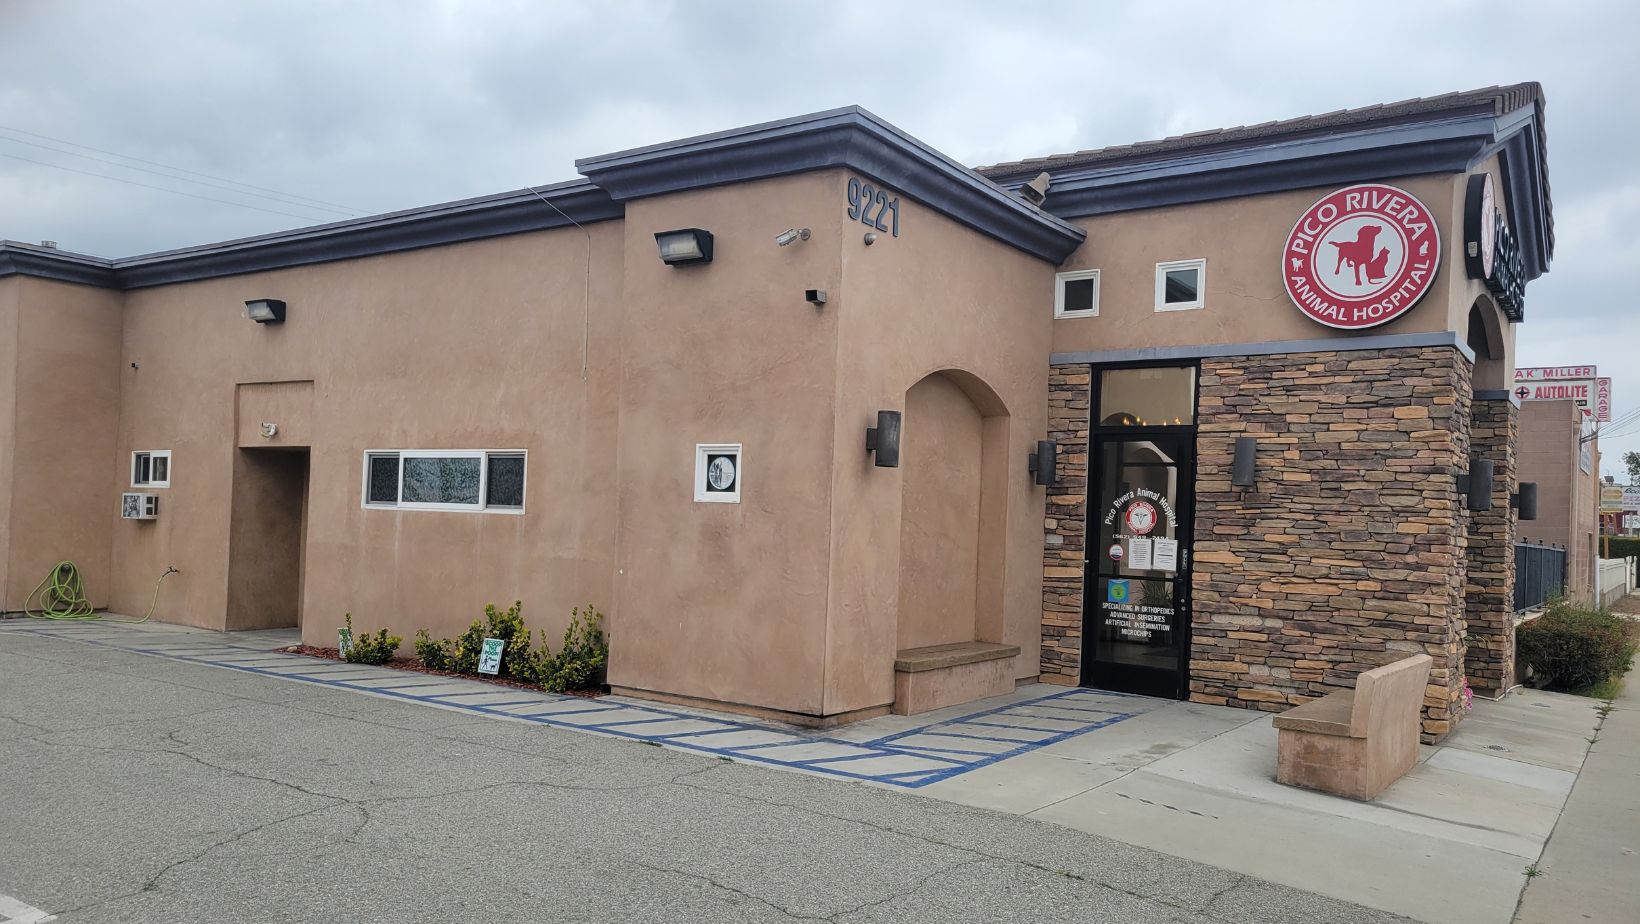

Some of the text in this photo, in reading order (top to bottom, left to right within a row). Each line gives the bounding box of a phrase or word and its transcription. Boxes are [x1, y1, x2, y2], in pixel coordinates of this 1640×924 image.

[847, 176, 899, 238] 9221
[1291, 203, 1338, 254] PICO
[1346, 191, 1428, 240] RIVERA
[1291, 276, 1348, 321] ANIMAL
[1353, 259, 1430, 321] HOSPITAL
[1515, 367, 1591, 378] AK MILLER
[1535, 384, 1588, 399] AUTOLITE
[1598, 379, 1609, 419] GARAGE
[1104, 508, 1116, 525] Pico
[1113, 491, 1135, 509] Rivera
[1136, 487, 1161, 501] Animal
[1158, 496, 1179, 528] Hospital
[1102, 602, 1132, 611] SPECIALIZING
[1141, 606, 1174, 615] ORTHOPEDICS
[1104, 618, 1171, 631] ARTIFICIAL INSEMINATION
[1109, 611, 1166, 623] ADVANCED SURGERIES
[1121, 628, 1152, 638] MICROCHIPS
